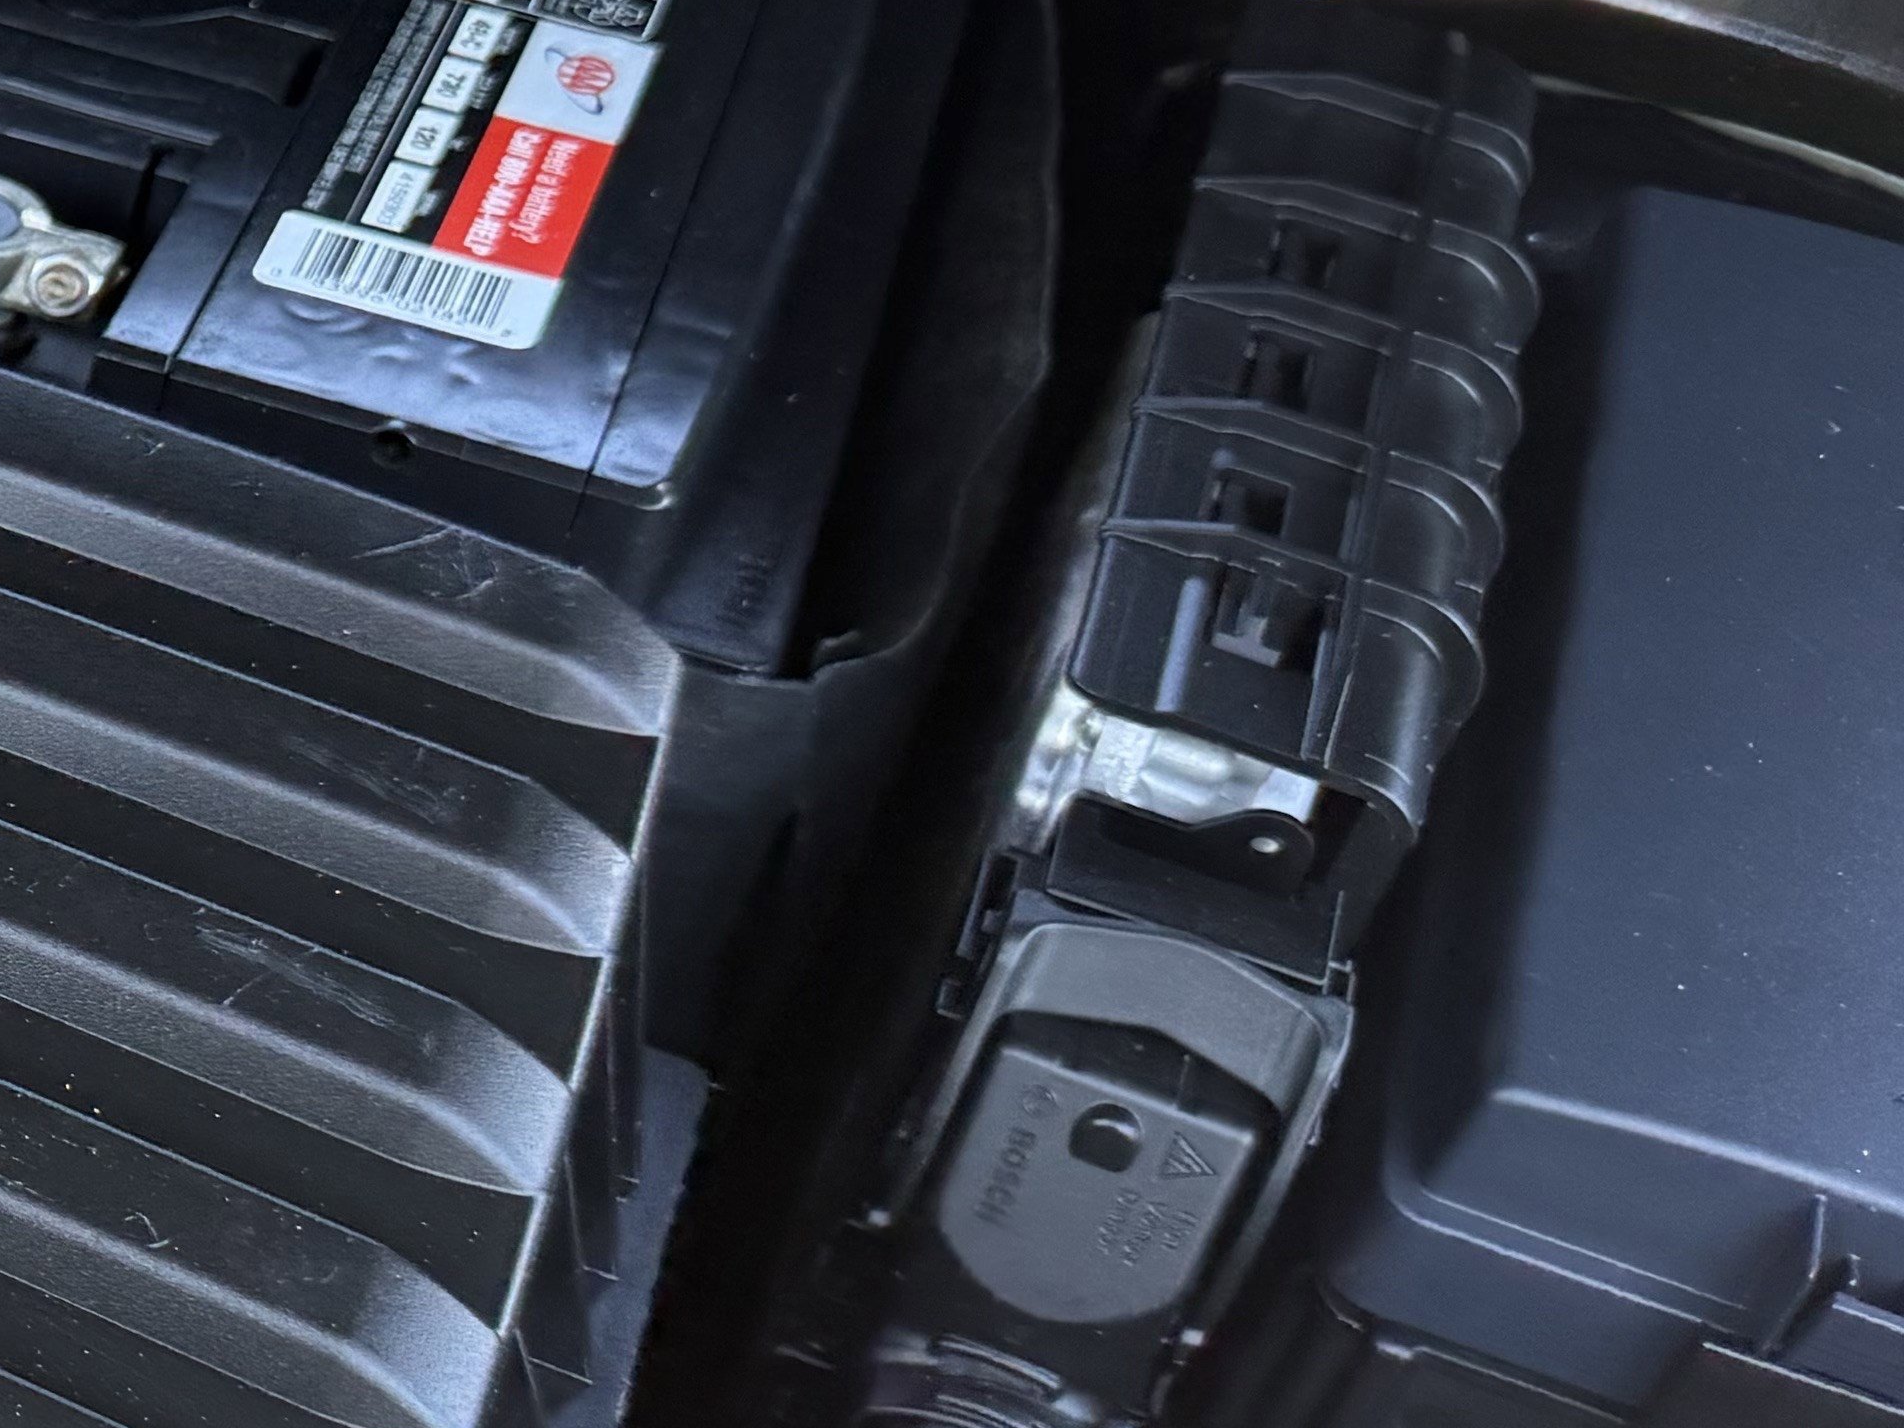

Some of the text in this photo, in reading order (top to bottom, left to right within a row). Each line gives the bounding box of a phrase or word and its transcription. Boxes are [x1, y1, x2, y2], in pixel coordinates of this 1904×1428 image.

[506, 126, 543, 159] Call
[508, 138, 585, 245] Need a battery?
[463, 154, 529, 257] 800-AAA-HELP
